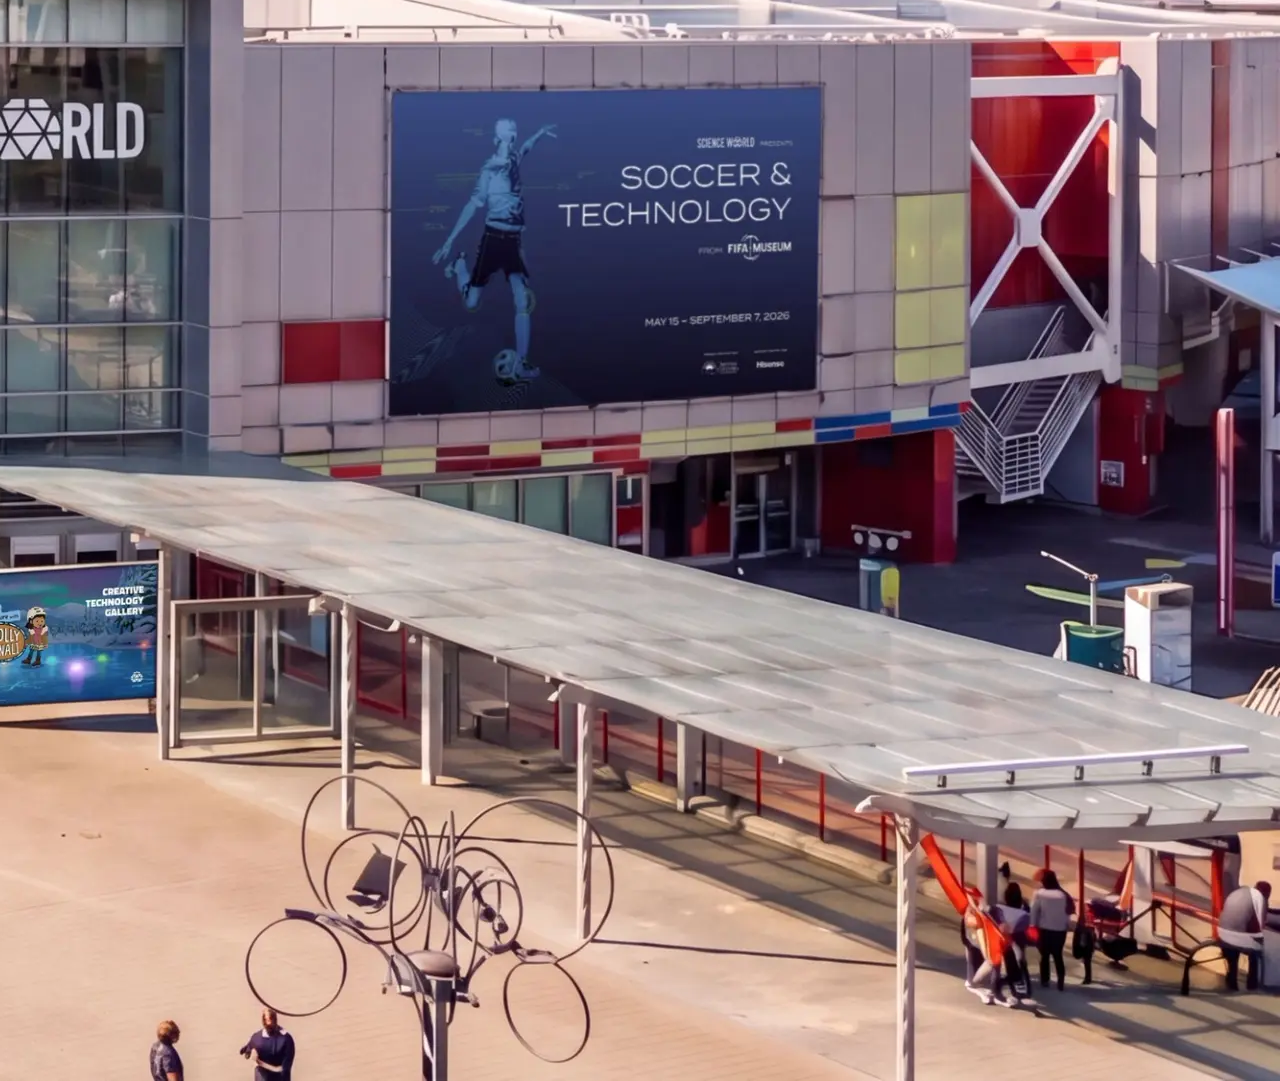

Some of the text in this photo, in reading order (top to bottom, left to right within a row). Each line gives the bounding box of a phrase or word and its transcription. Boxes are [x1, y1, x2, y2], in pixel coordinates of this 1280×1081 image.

[697, 137, 725, 149] SCIENCE
[727, 136, 755, 148] WORLD
[621, 162, 792, 190] SOCCER &
[558, 197, 792, 227] TECHNOLOGY
[727, 243, 749, 254] FIFA
[753, 241, 792, 253] MUSEUM
[645, 317, 666, 327] MAY
[669, 317, 680, 326] 15
[690, 313, 752, 325] SEPTEMBER
[763, 311, 790, 321] 2026
[756, 360, 785, 369] Hisense
[102, 585, 145, 596] CREATIVE
[85, 596, 144, 608] TECHNOLOGY
[104, 607, 144, 617] GALLERY
